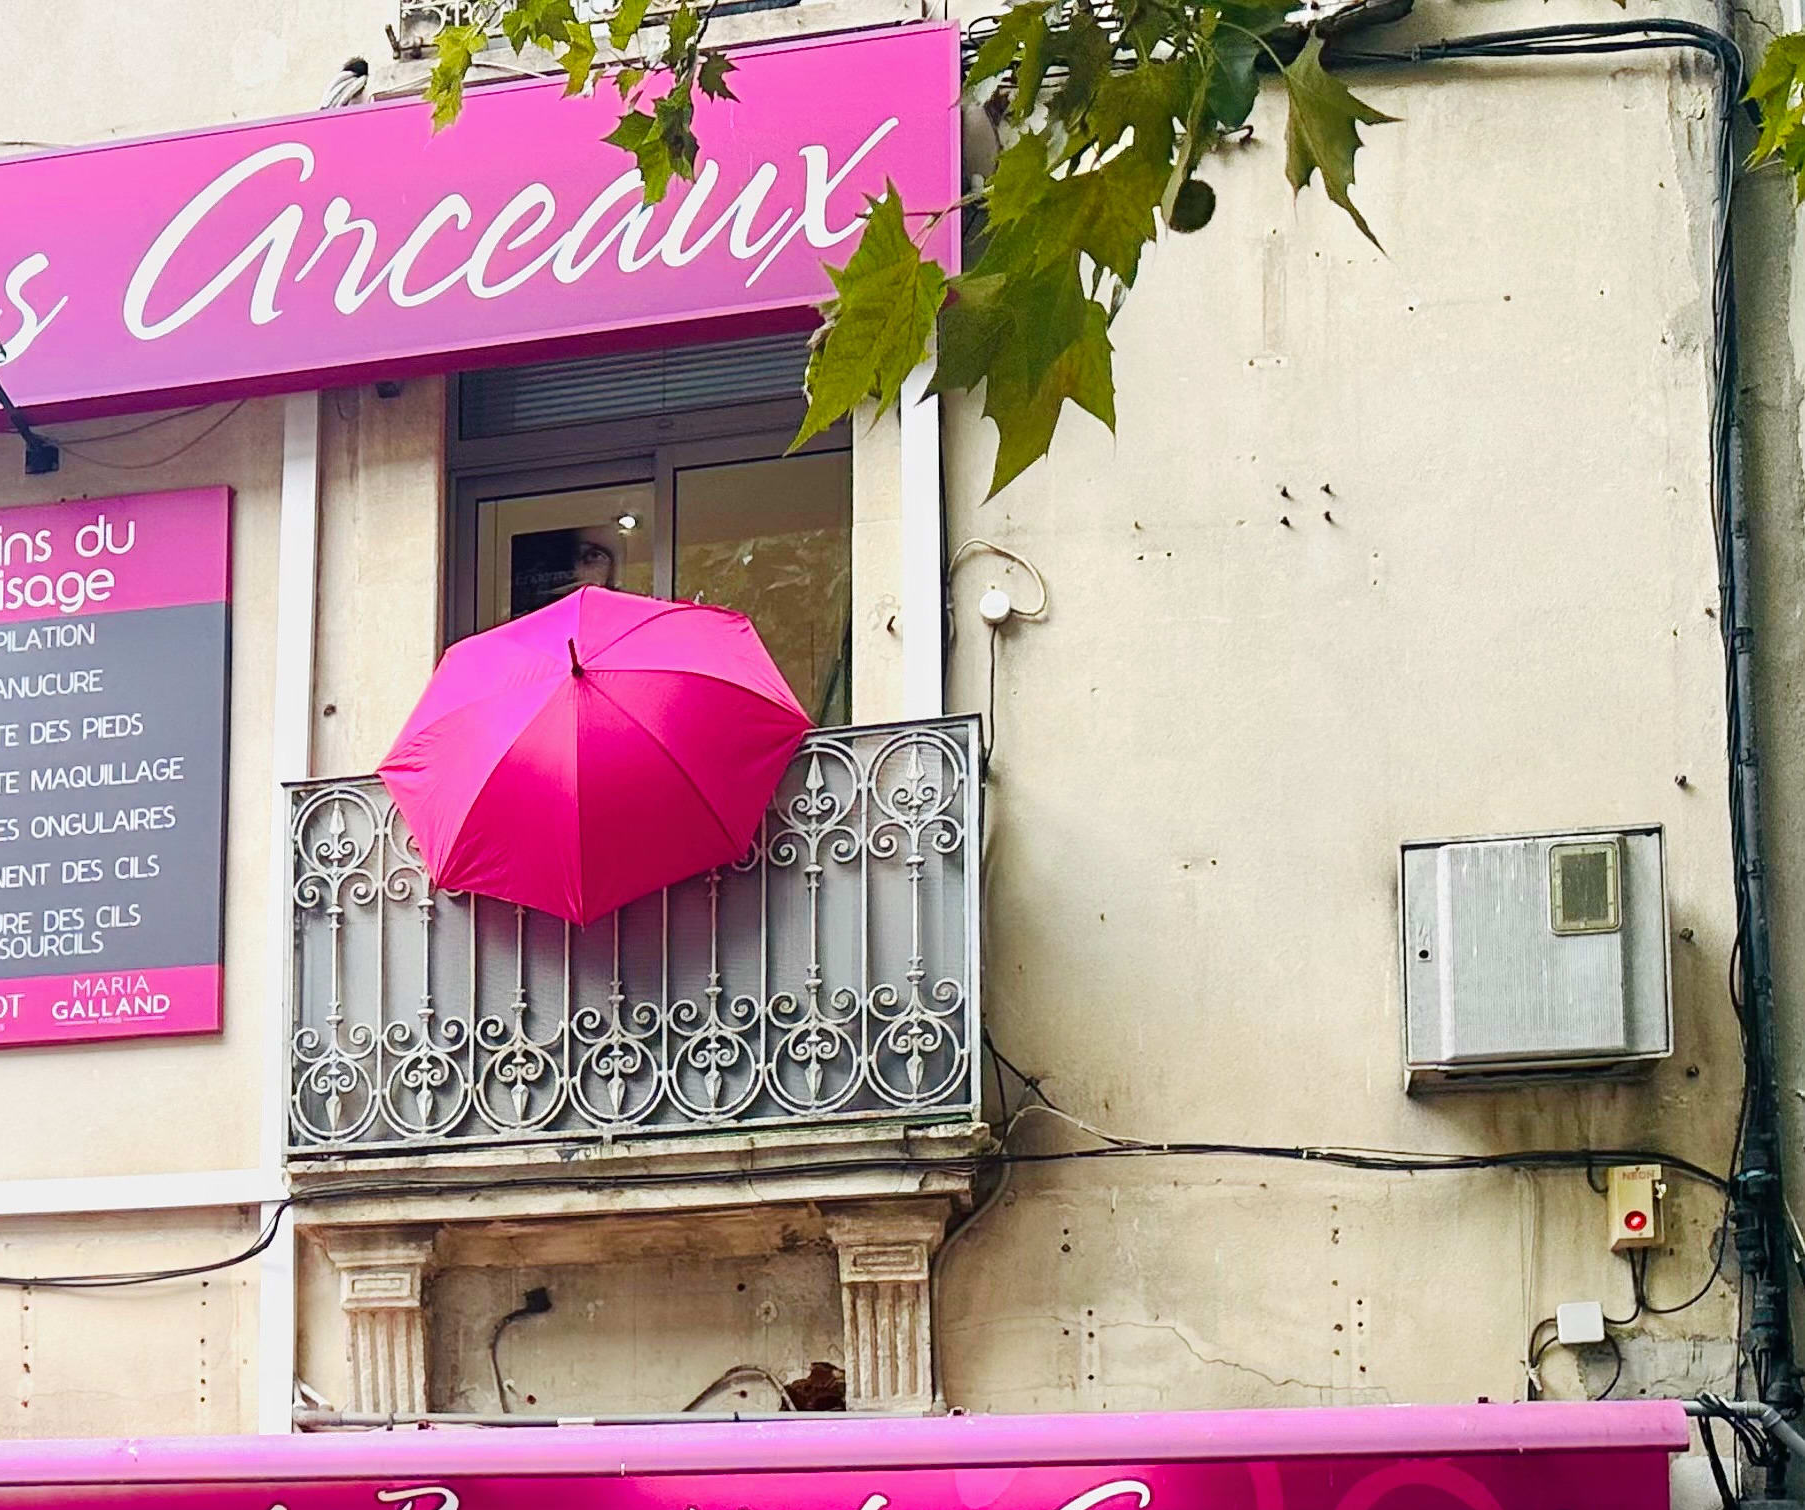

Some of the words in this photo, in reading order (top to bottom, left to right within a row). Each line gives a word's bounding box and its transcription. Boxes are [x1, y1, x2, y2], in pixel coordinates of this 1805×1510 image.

[122, 117, 899, 341] Arceaux
[74, 513, 136, 557] du
[30, 719, 72, 745] DES
[82, 713, 144, 741] PIEDS
[30, 757, 184, 794] MAQUILLAGE
[31, 806, 176, 841] ONGULAIRES
[61, 859, 103, 885] DES
[114, 855, 160, 880] CILS
[44, 908, 84, 933] DES
[96, 904, 141, 928] CILS
[72, 975, 150, 998] MARIA
[51, 994, 171, 1020] GALLAND
